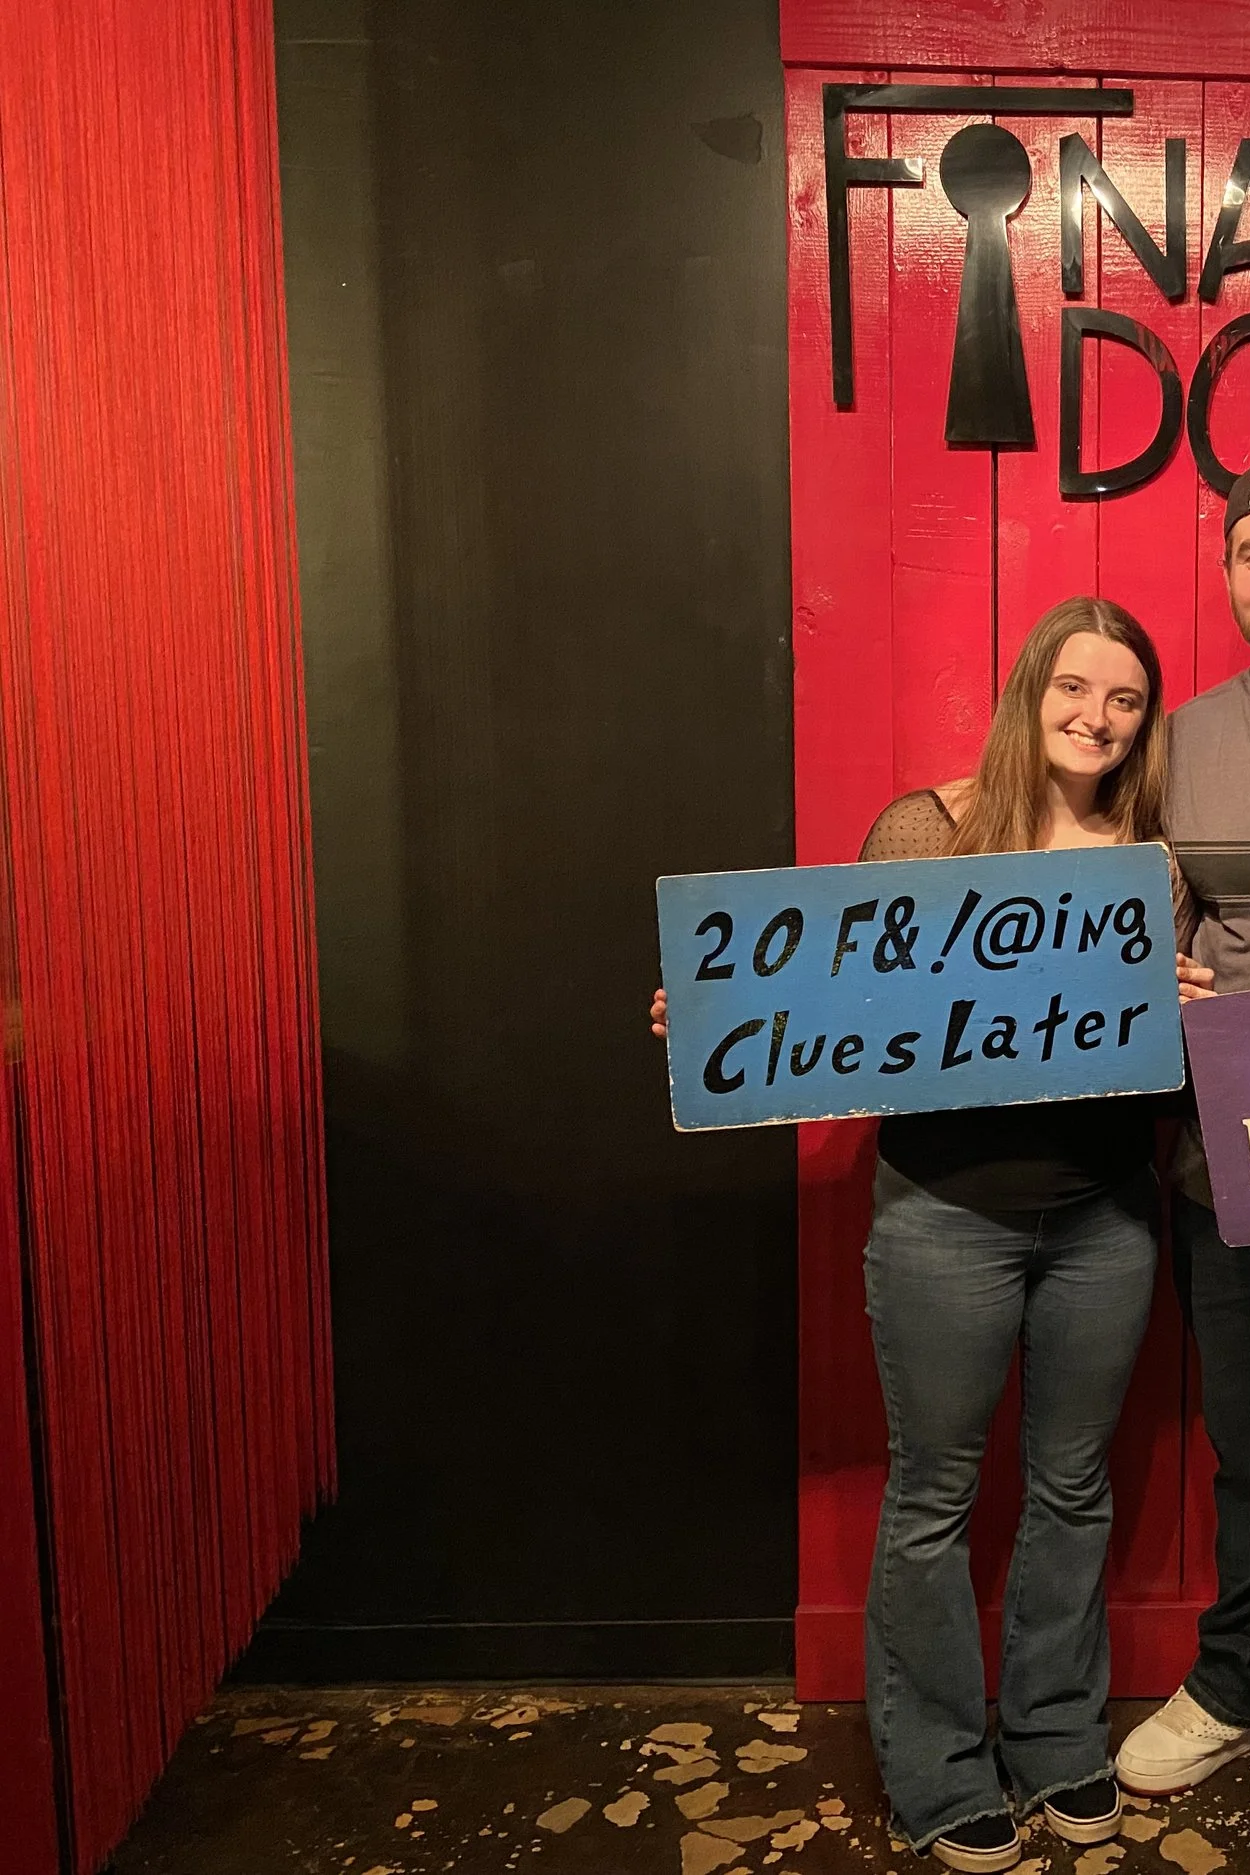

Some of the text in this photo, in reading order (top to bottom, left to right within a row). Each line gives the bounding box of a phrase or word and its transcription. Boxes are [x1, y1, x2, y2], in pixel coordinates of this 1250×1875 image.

[694, 907, 803, 981] 20
[703, 993, 1149, 1094] Clues Later
